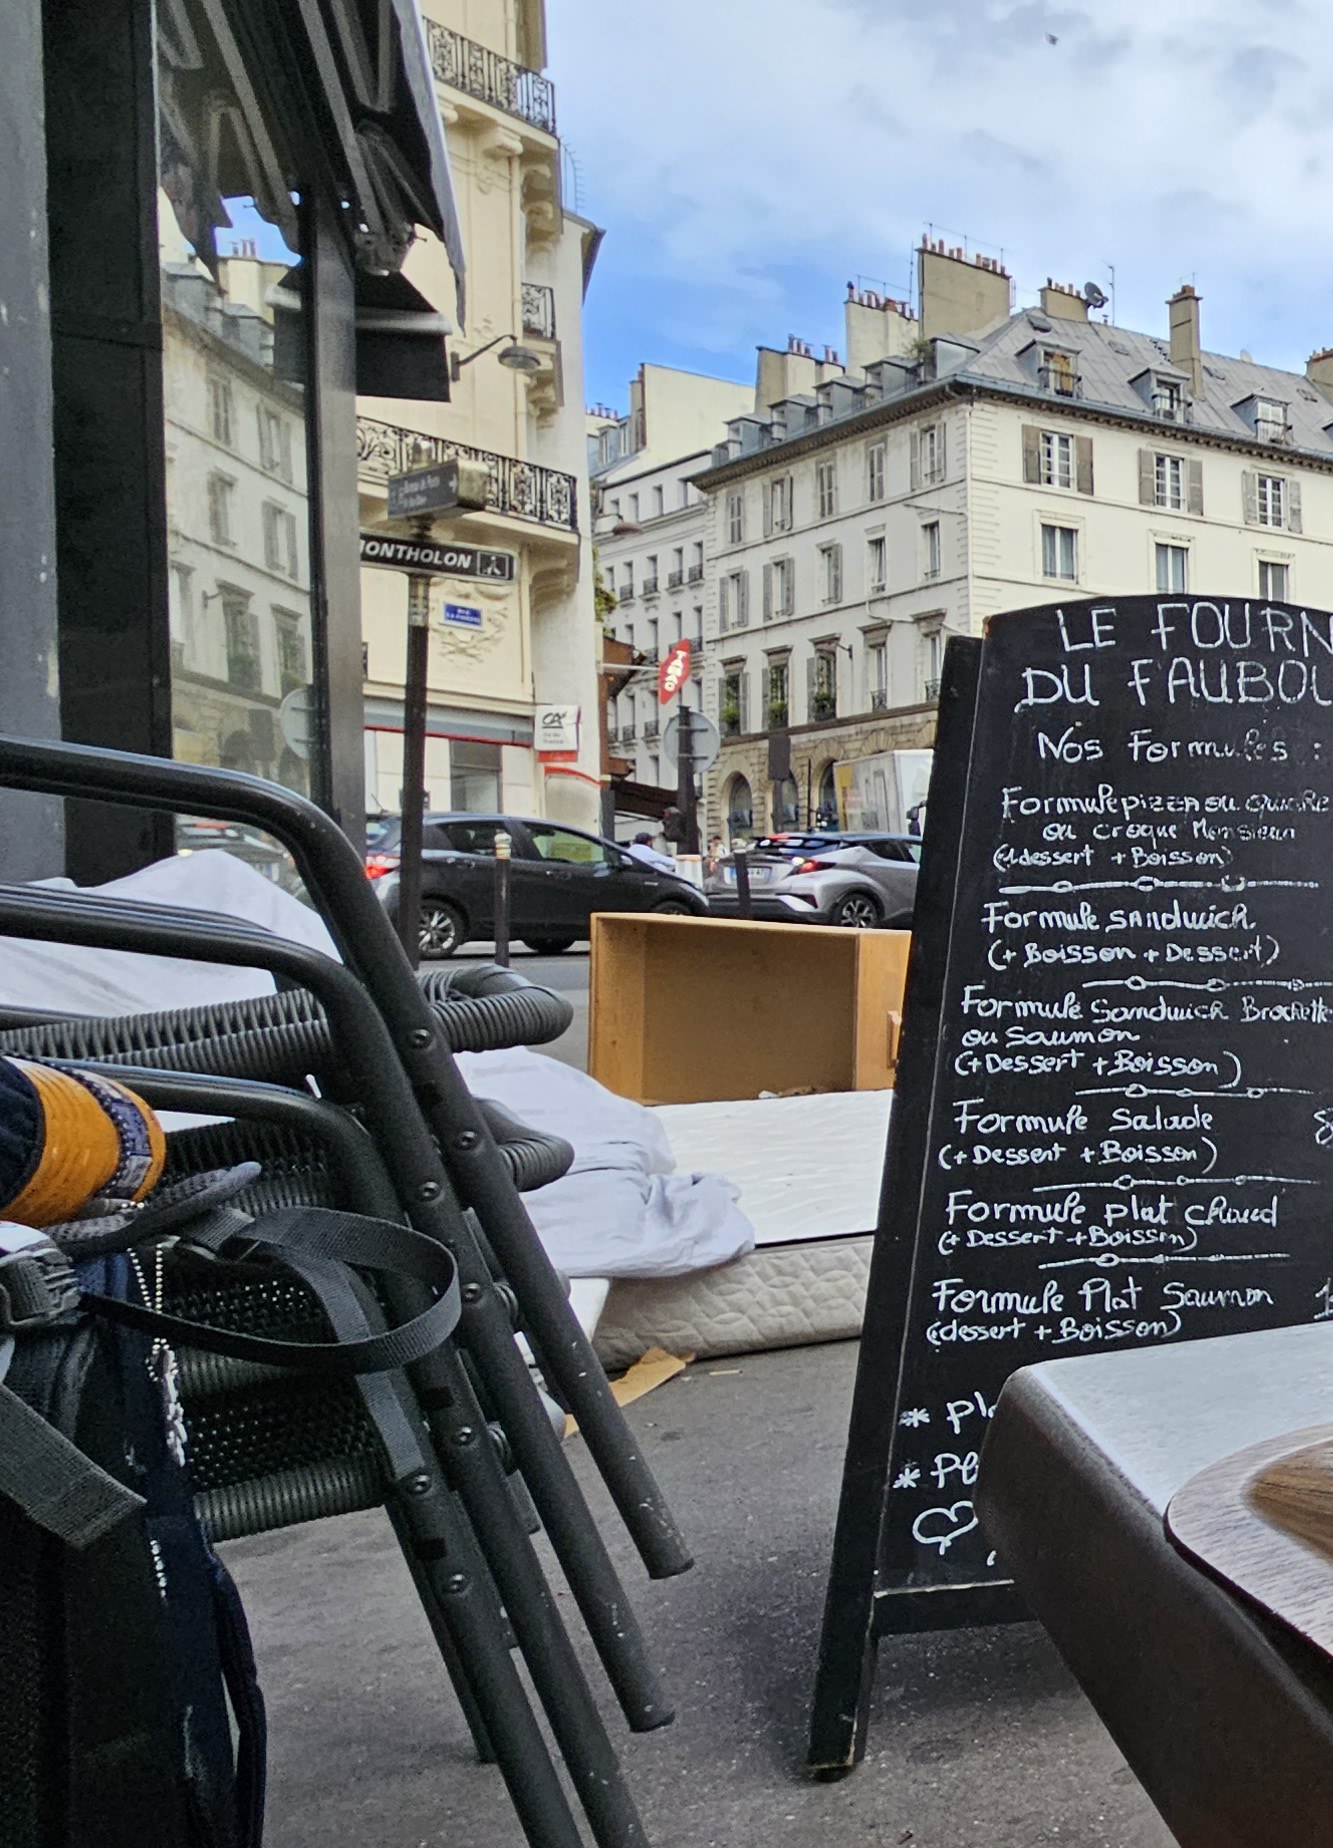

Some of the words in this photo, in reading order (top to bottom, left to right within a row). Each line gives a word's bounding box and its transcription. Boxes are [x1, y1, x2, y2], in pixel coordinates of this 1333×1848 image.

[1056, 605, 1117, 652] LE
[1013, 663, 1100, 714] DU
[1037, 721, 1104, 764] Nos
[1127, 728, 1289, 763] Formules
[980, 900, 1100, 934] Formule
[960, 983, 1087, 1020] Formule
[1090, 997, 1229, 1024] Sandwich
[961, 1029, 999, 1047] ou
[952, 1097, 1088, 1135] Formule
[1108, 1103, 1213, 1132] Salade
[945, 1189, 1086, 1226] Formule
[931, 1277, 1064, 1315] Formule
